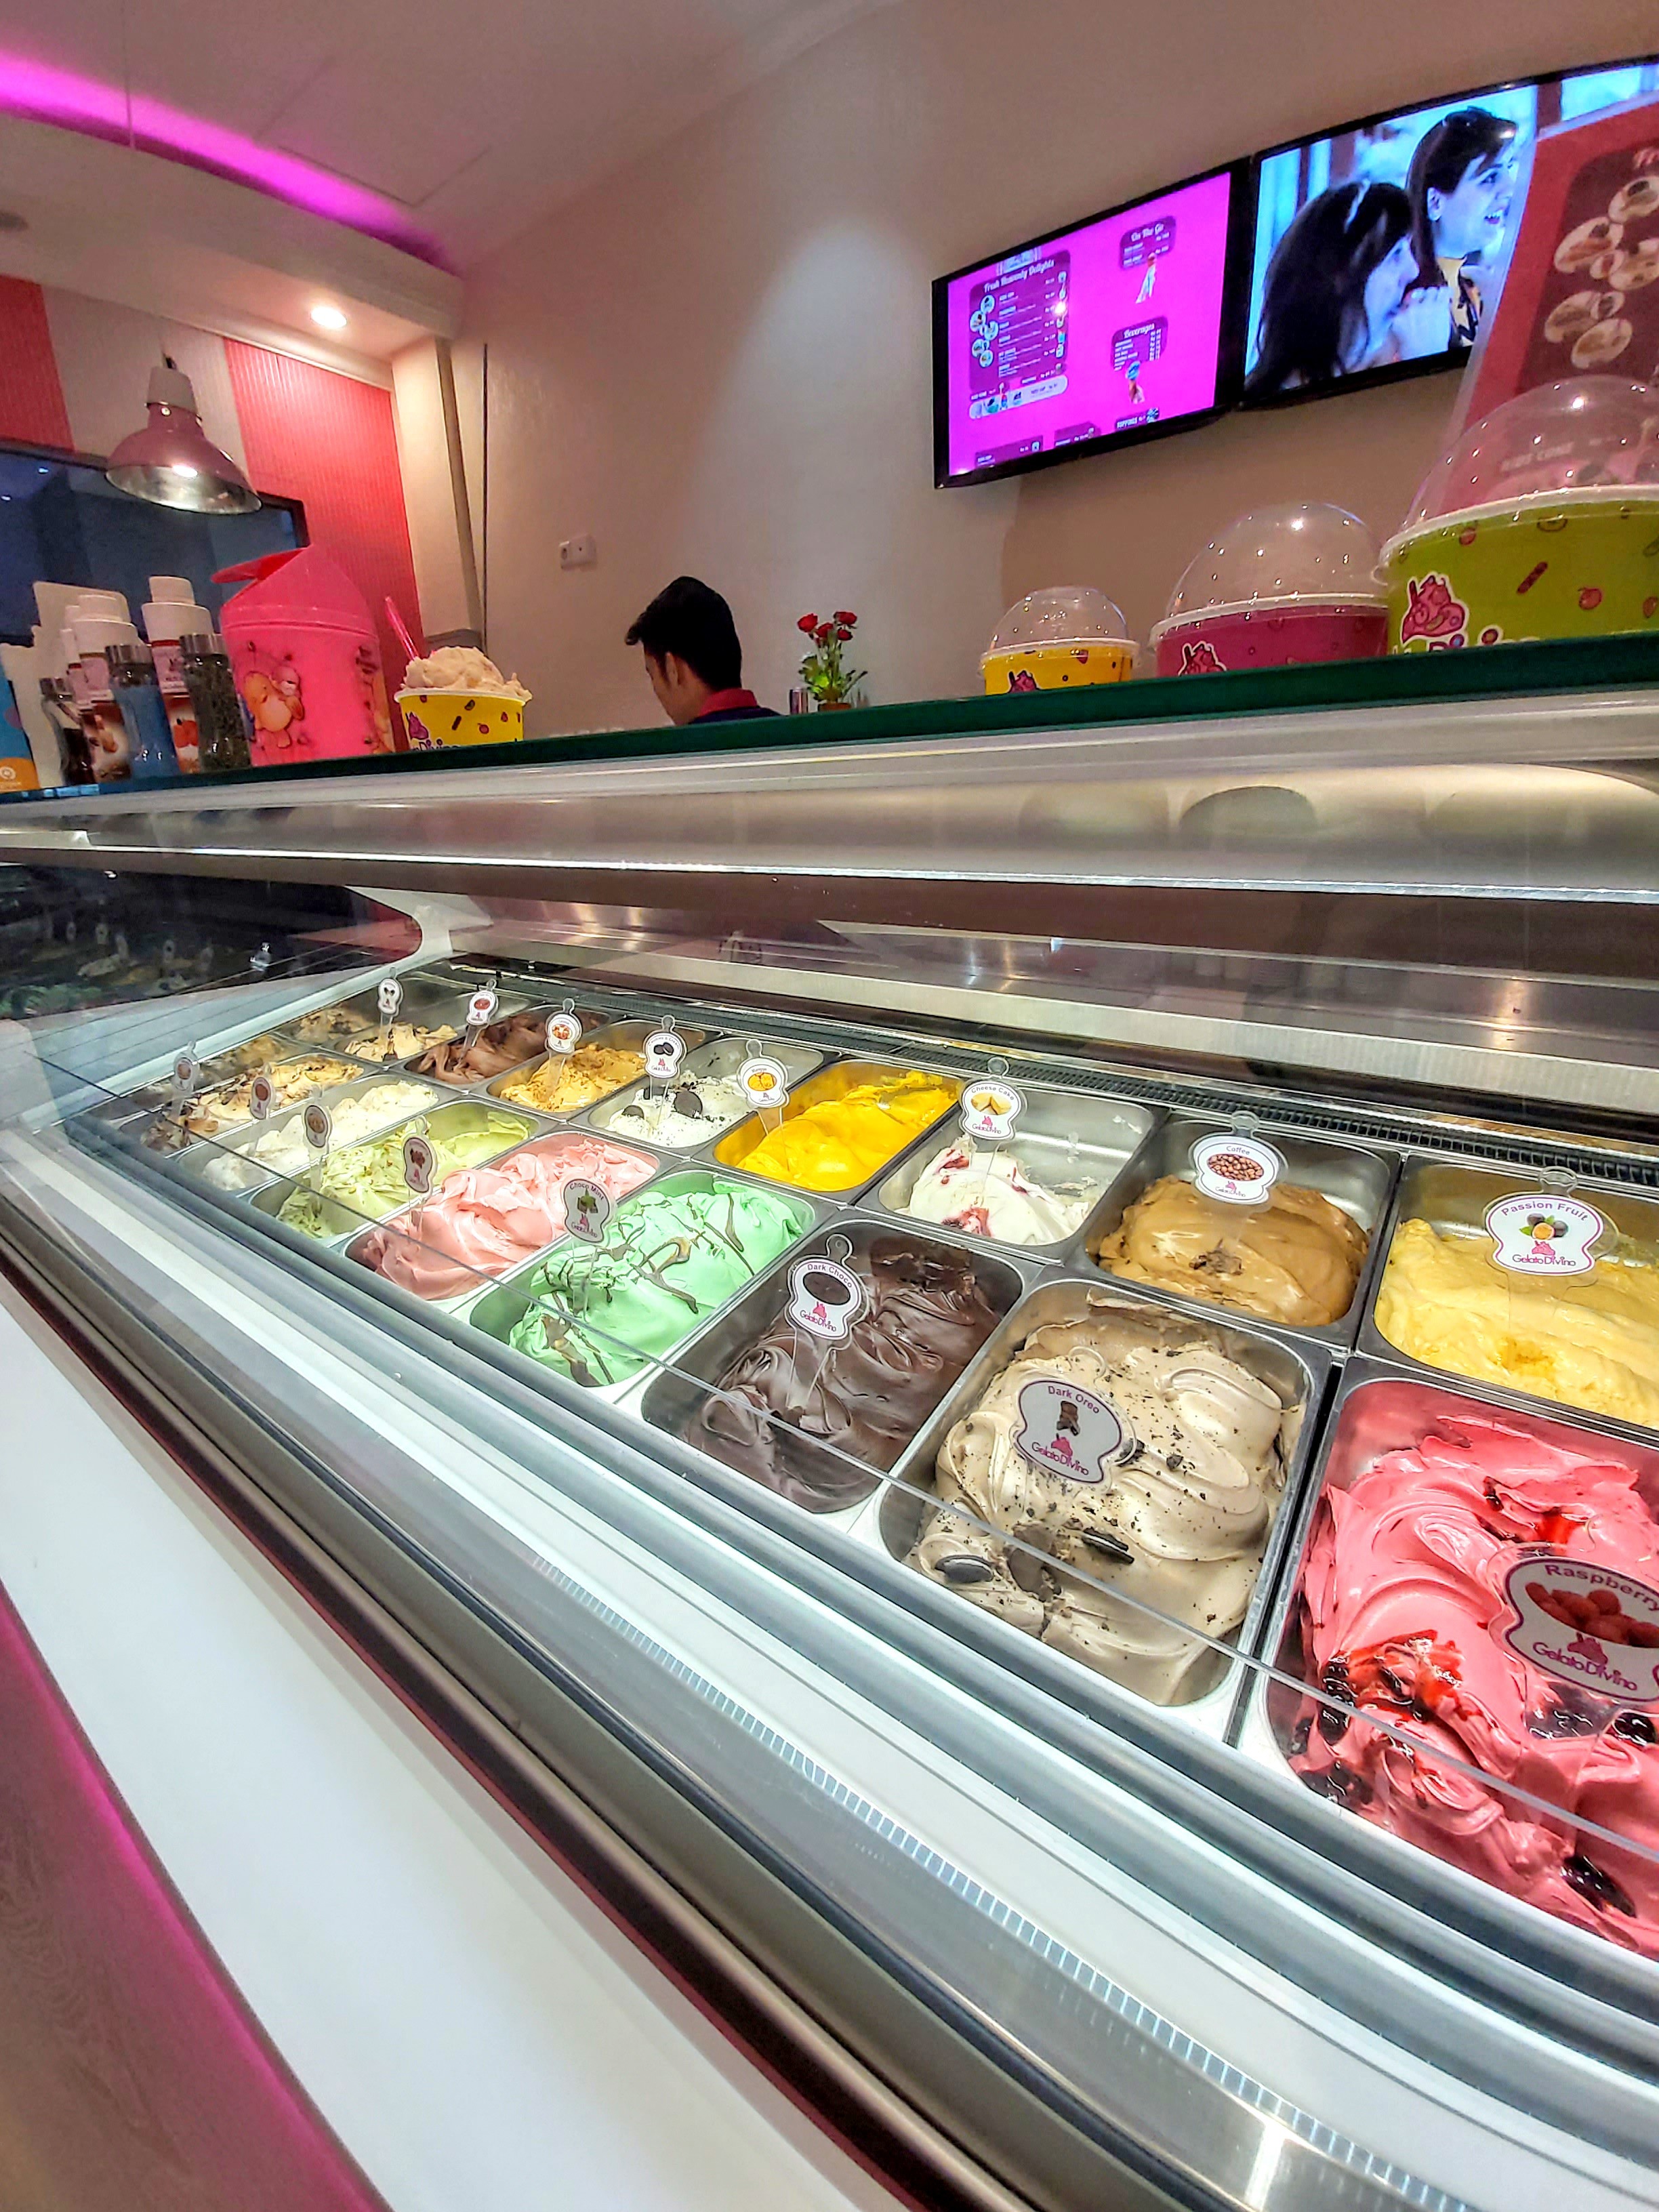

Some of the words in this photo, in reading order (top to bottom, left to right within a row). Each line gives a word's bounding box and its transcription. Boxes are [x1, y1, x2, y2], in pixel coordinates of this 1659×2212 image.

[1124, 323, 1155, 338] Beverages
[998, 1087, 1014, 1101] Cake
[1226, 1145, 1250, 1155] Coffee
[569, 1182, 589, 1190] Choco
[590, 1185, 605, 1200] Mint
[1500, 1201, 1553, 1216] Passion
[1557, 1203, 1589, 1221] Fruit
[828, 1266, 852, 1288] Choco
[1048, 1386, 1073, 1399] Dark
[1076, 1394, 1100, 1414] Oreo
